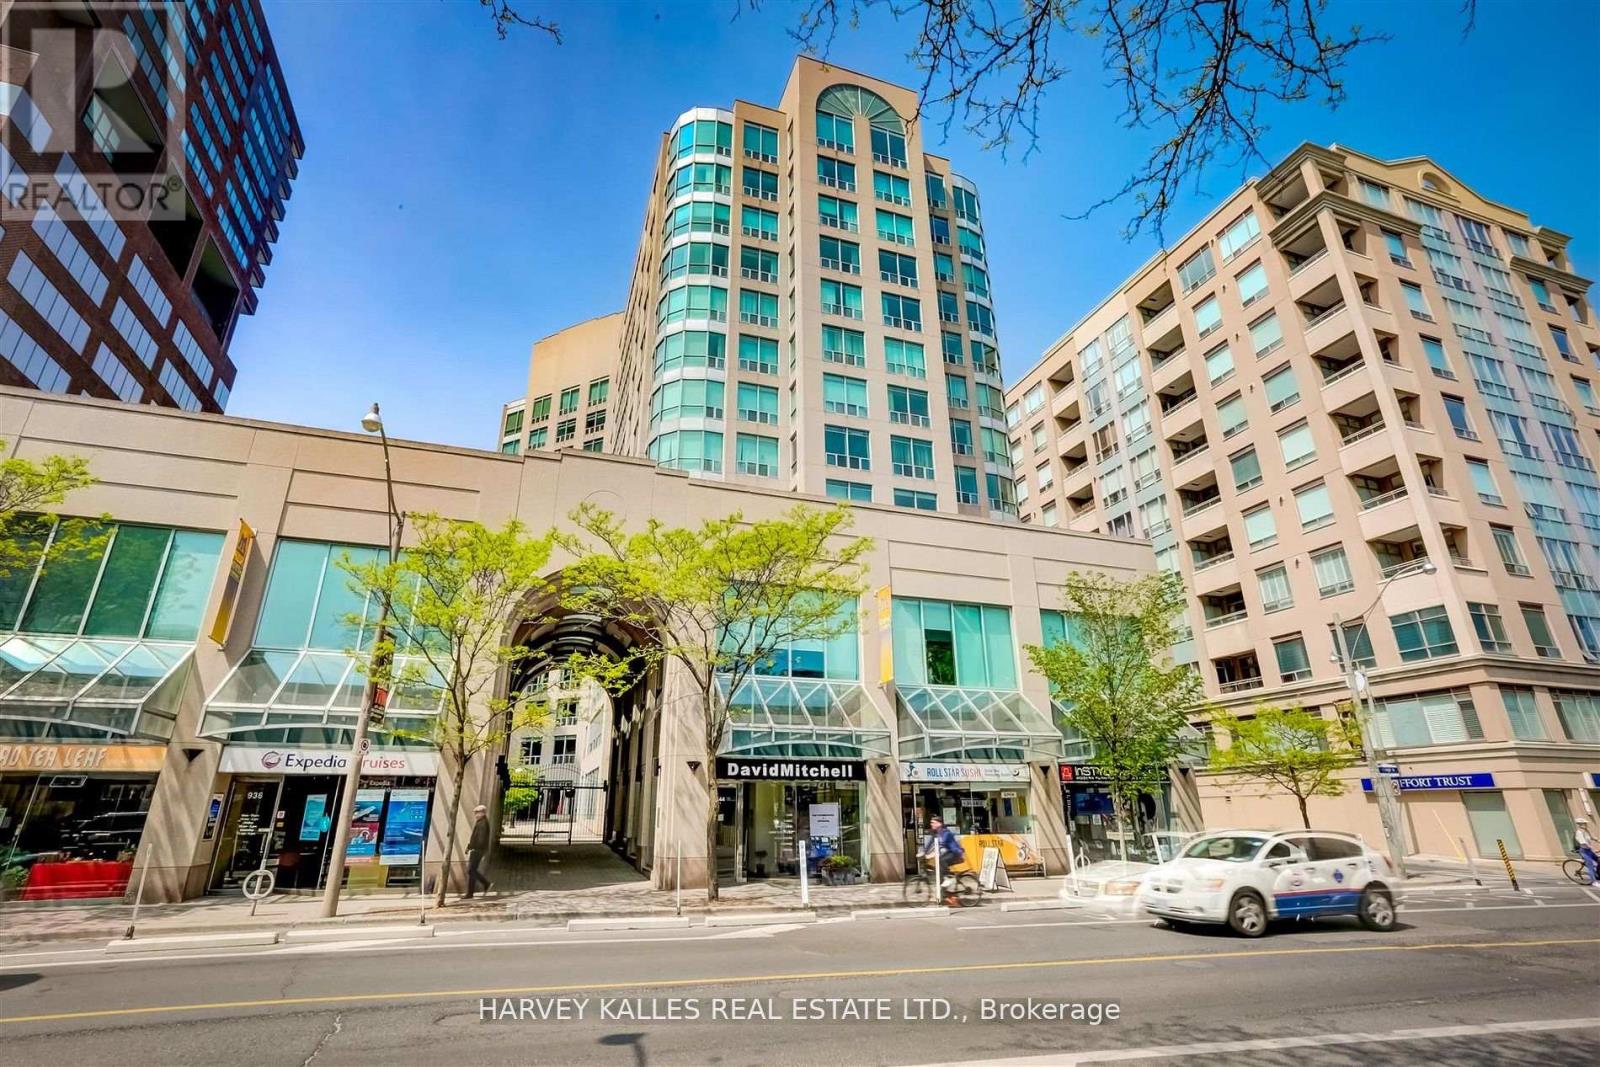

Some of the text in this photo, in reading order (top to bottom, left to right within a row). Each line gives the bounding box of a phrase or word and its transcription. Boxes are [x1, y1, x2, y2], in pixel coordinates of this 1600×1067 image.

[27, 745, 57, 768] TEA
[63, 747, 107, 768] LEAF
[285, 754, 406, 771] Expedia ruises
[727, 762, 853, 778] DavidMitchell
[927, 767, 943, 778] ROLL
[944, 767, 960, 778] STAR
[1400, 776, 1472, 788] FFORT TRUST
[247, 791, 264, 799] 936
